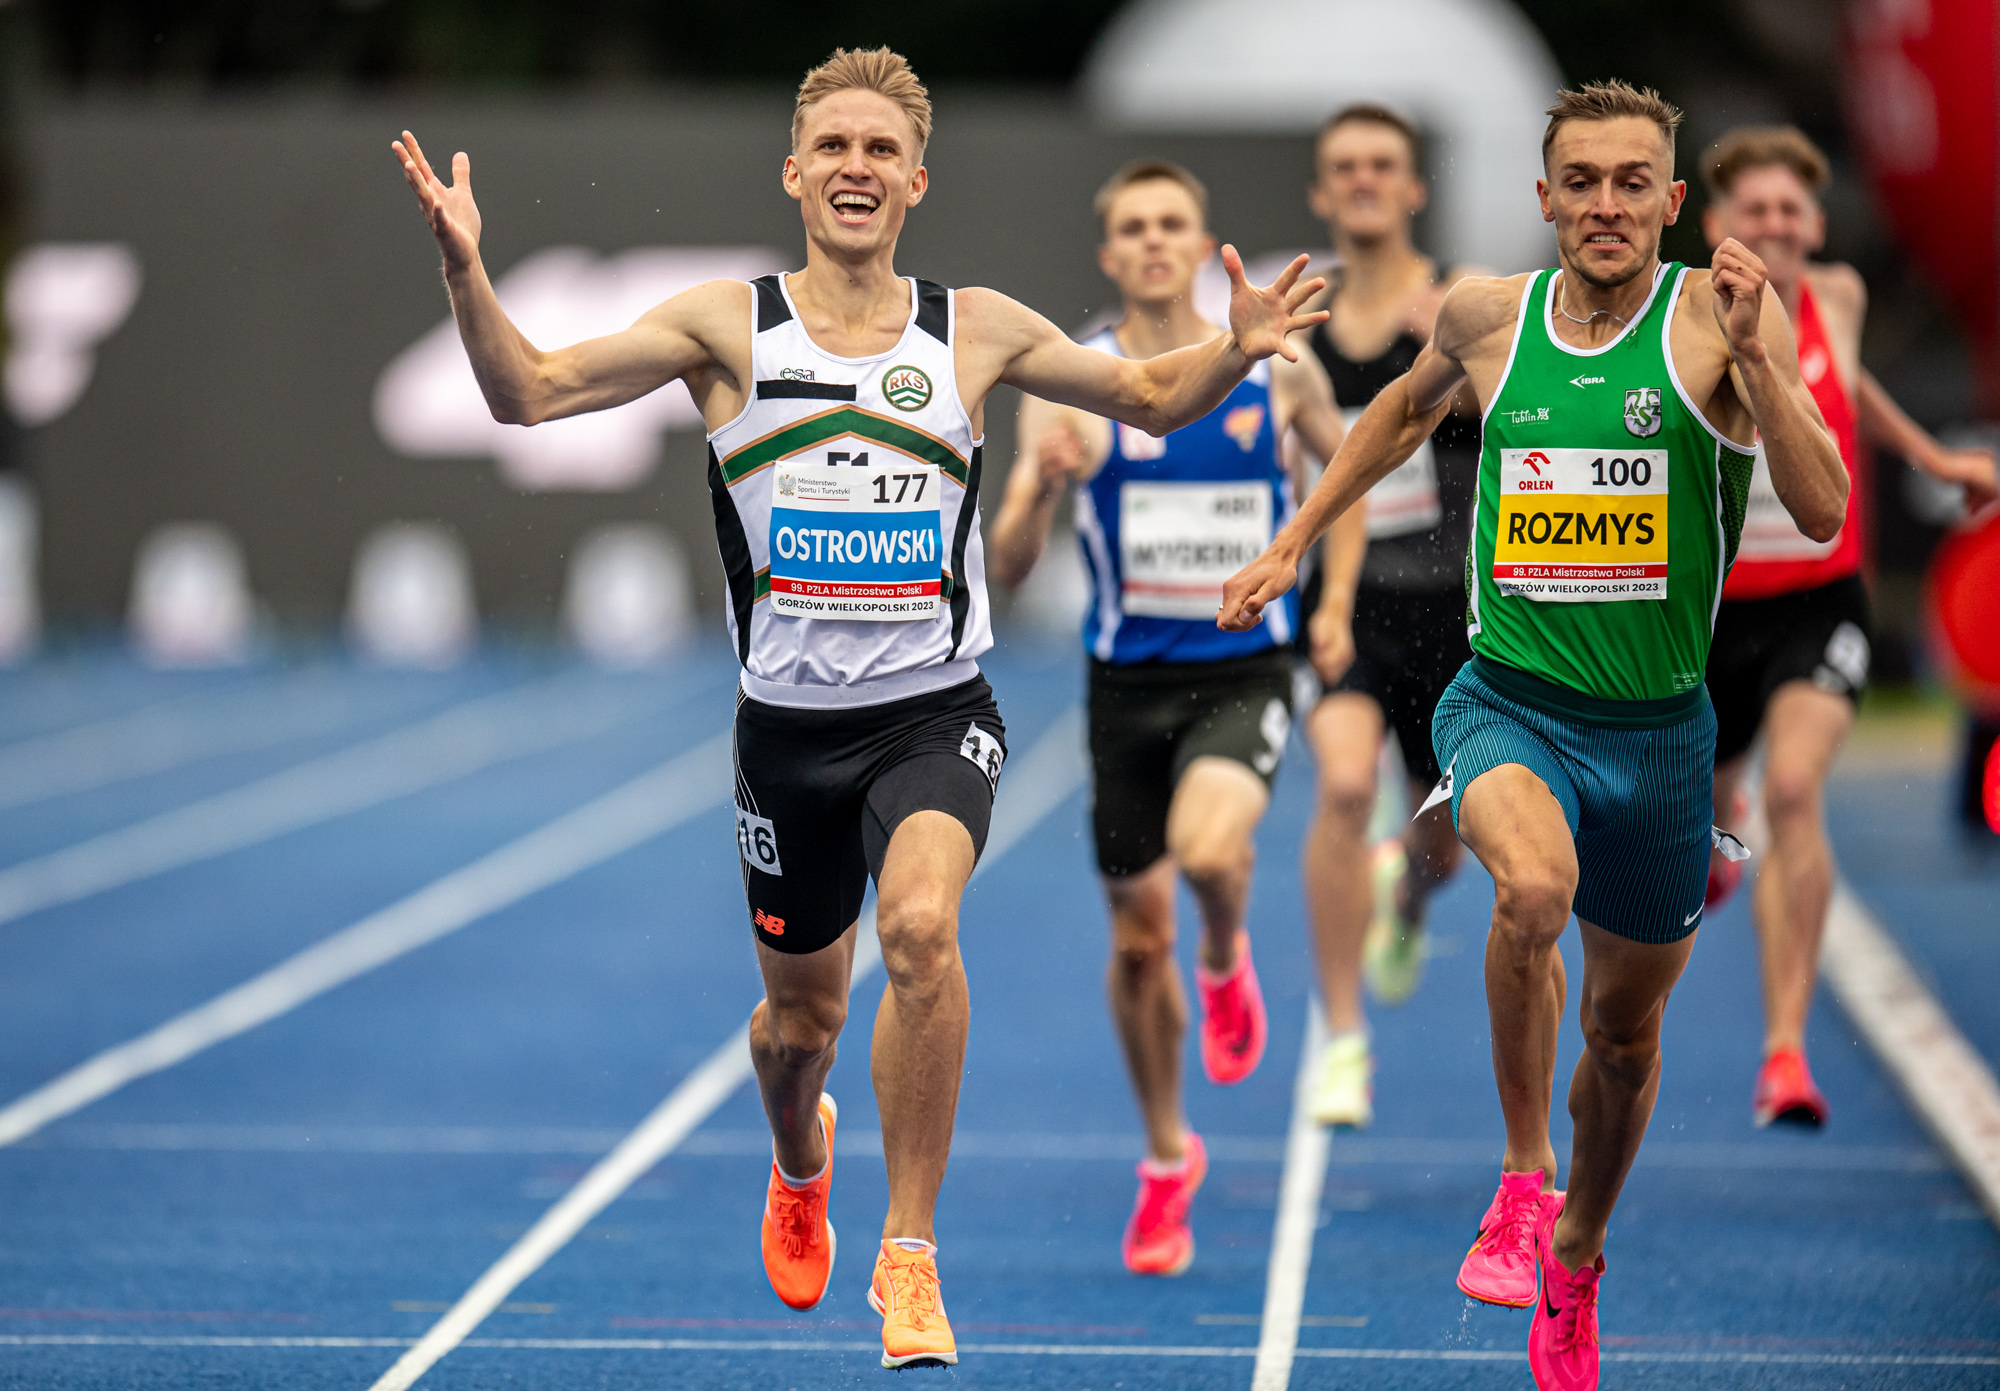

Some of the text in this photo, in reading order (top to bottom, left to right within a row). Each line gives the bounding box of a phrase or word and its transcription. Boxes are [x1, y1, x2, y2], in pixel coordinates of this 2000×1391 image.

[890, 372, 924, 390] RKS
[1591, 457, 1651, 486] 100
[798, 478, 837, 487] Ministerstwo
[872, 473, 928, 503] 177
[1519, 481, 1553, 490] ORLEN
[798, 486, 816, 495] Sportu
[822, 487, 850, 496] Turystyki
[1508, 512, 1655, 545] ROZMYS
[776, 526, 935, 564] OSTROWSKI
[1513, 567, 1645, 577] 99. PZLA Mistrzostwa Polski
[791, 583, 922, 596] 99. PZLA Mistrzostwa Polski
[1548, 583, 1629, 593] WIELKOPOLSKI
[1632, 582, 1659, 592] 2023
[778, 598, 934, 612] GORZÓW WIELKOPOLSKI 2023
[740, 818, 776, 865] 16
[754, 908, 785, 935] NB
